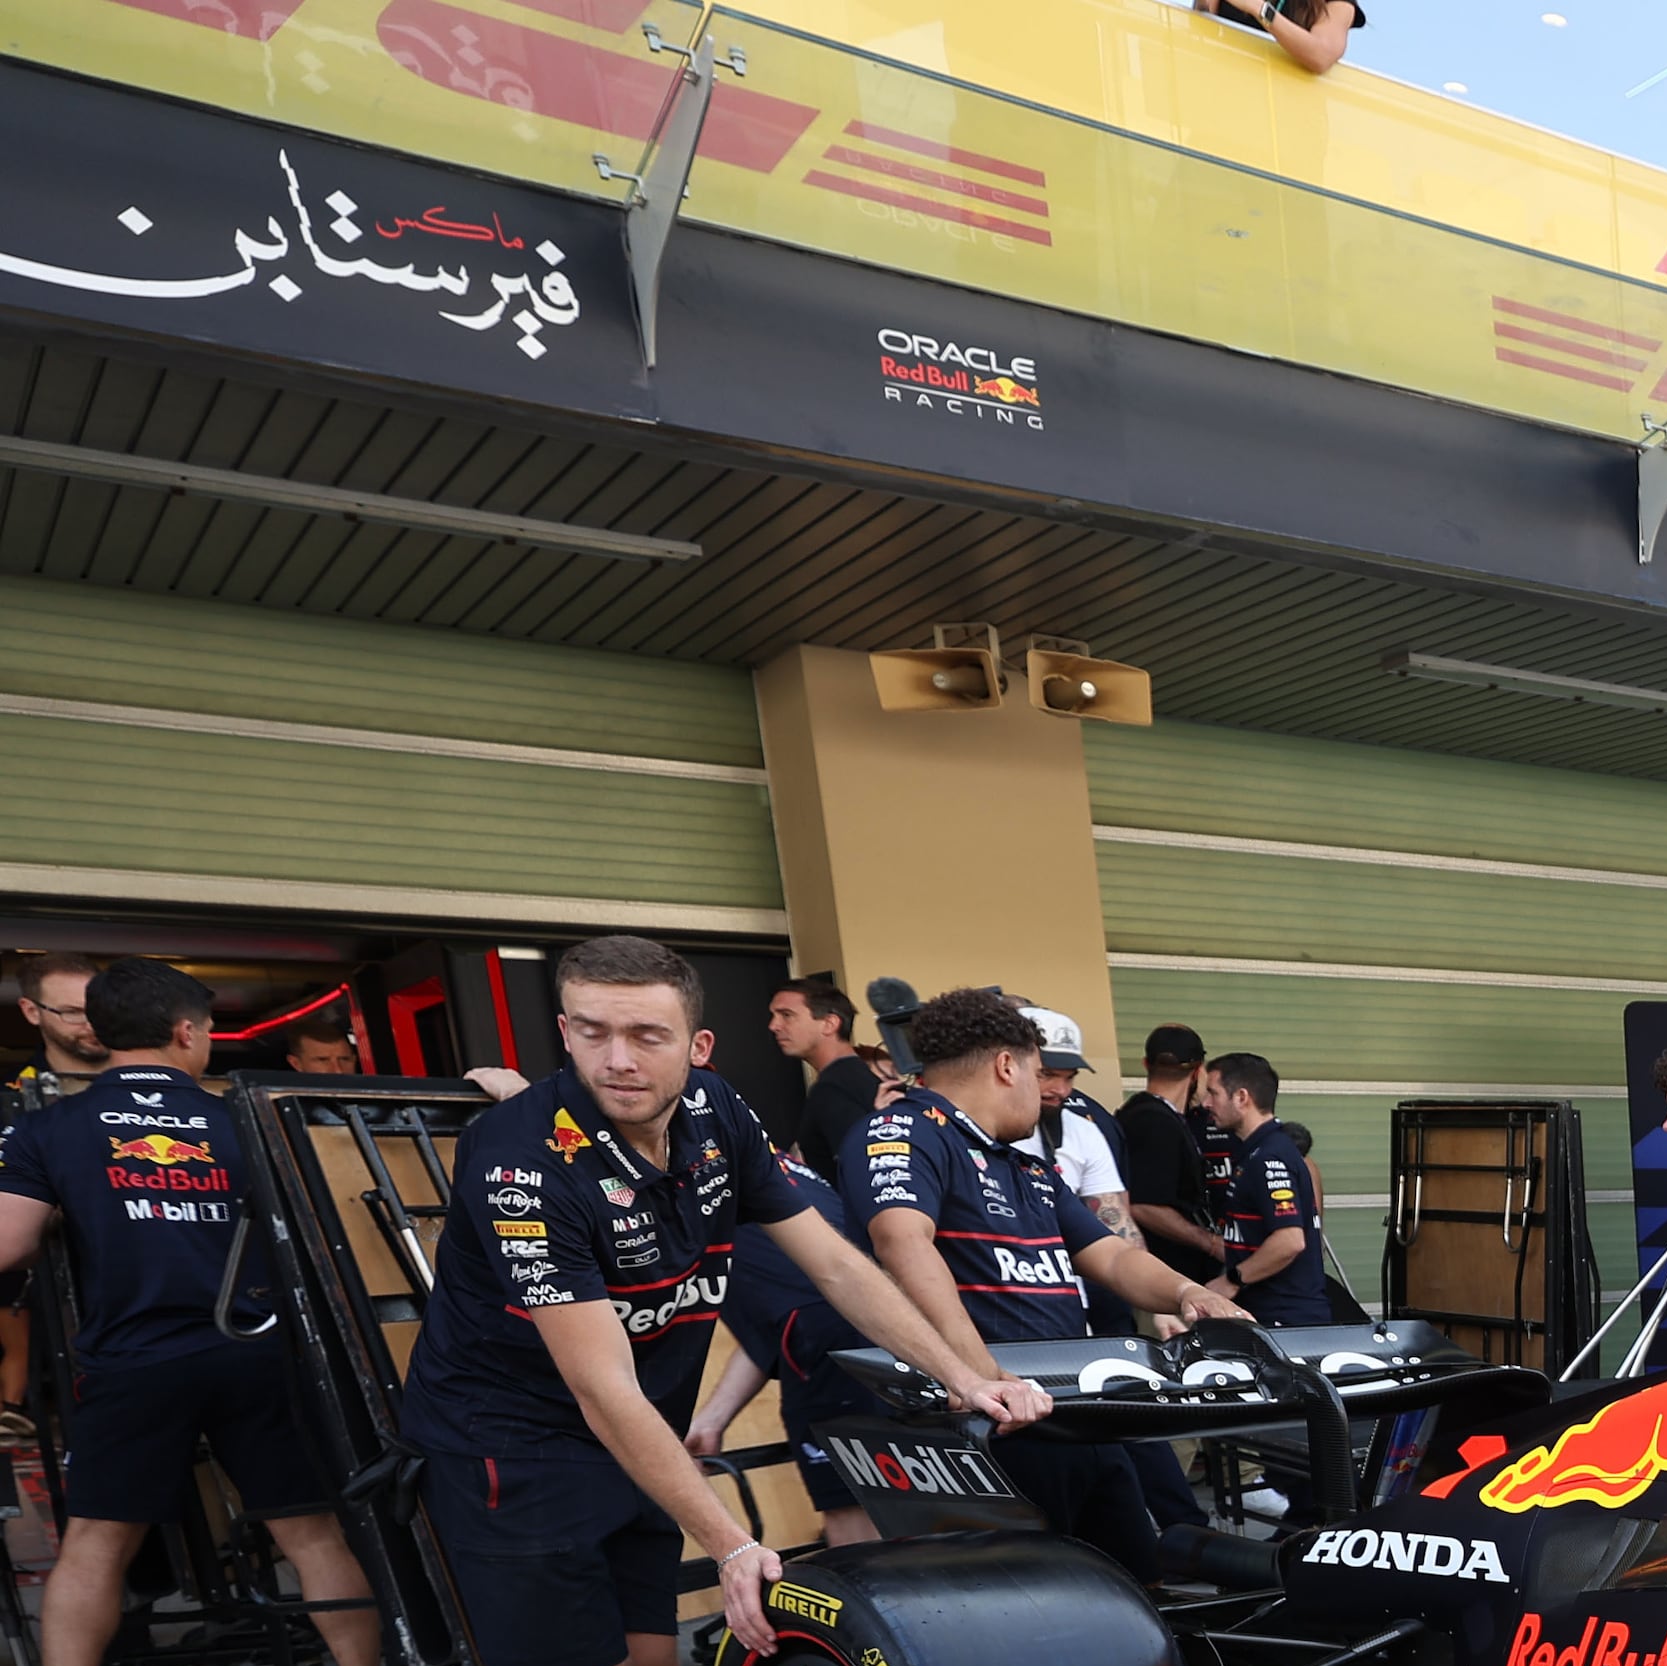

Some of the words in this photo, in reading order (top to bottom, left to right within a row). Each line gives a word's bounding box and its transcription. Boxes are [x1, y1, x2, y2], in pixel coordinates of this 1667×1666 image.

[375, 206, 525, 251] ماكس
[877, 327, 1037, 383] ORACLE
[884, 385, 1044, 431] RACING
[120, 1073, 173, 1081] HONDA
[100, 1112, 208, 1128] ORACLE
[869, 1114, 914, 1127] Mobil
[869, 1156, 910, 1171] HRC
[1265, 1161, 1286, 1169] VISA
[106, 1166, 166, 1189] Red
[168, 1168, 230, 1191] Bull
[485, 1166, 542, 1187] Mobil
[1268, 1180, 1291, 1189] ROKT
[874, 1192, 918, 1203] TRADE
[124, 1199, 197, 1221] Mobil
[495, 1223, 541, 1234] PIRELLI
[501, 1240, 549, 1254] HRC
[994, 1247, 1055, 1284] Red
[527, 1284, 558, 1296] AVA
[521, 1291, 575, 1306] TRADE
[827, 1436, 962, 1496] Mobil
[1303, 1528, 1510, 1583] HONDA
[768, 1582, 843, 1627] PIRELLI
